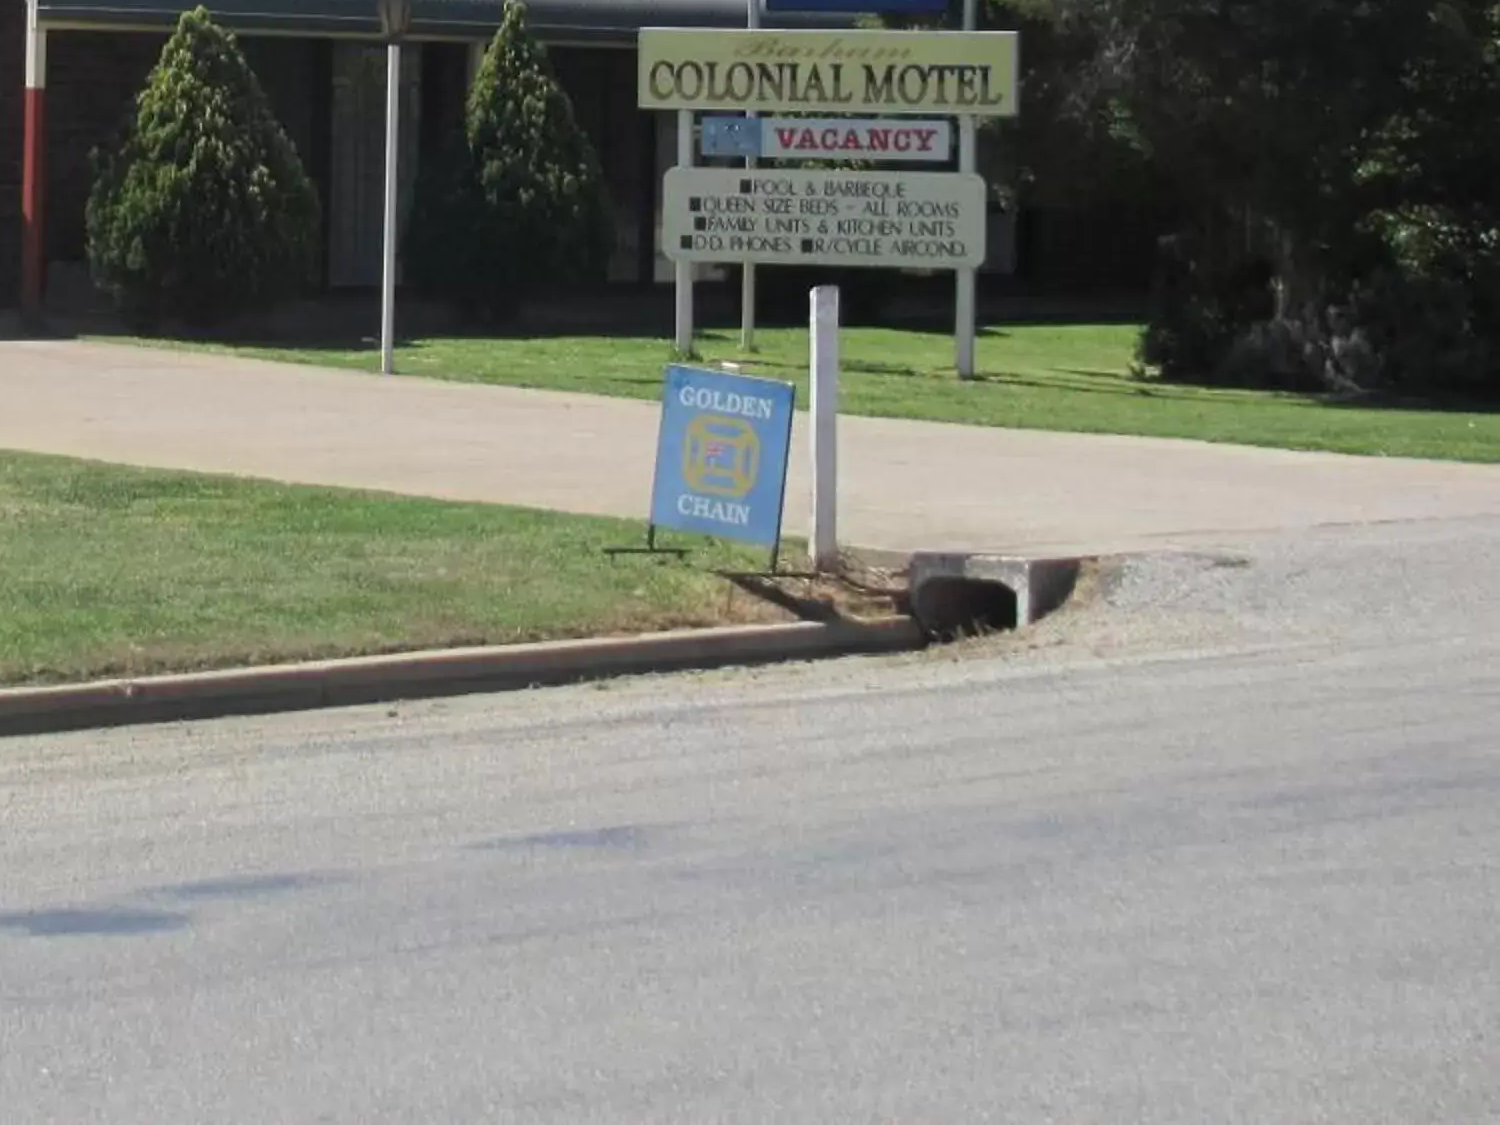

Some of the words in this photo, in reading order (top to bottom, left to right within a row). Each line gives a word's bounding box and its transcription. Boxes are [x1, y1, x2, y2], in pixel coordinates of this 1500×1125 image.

[648, 60, 852, 103] COLONIAL
[861, 64, 1003, 106] MOTEL
[773, 126, 938, 152] VACANCY
[753, 178, 797, 196] POOL
[805, 180, 816, 196] &
[703, 196, 755, 213] QUEEN
[763, 198, 792, 214] SIZE
[800, 198, 838, 215] BEDS
[863, 200, 889, 217] ALL
[897, 200, 960, 219] ROOMS
[707, 215, 758, 232] FAMILY
[765, 217, 810, 234] UNITS
[817, 219, 829, 235] &
[837, 218, 903, 236] KITCHEN
[910, 220, 955, 237] UNITS
[730, 235, 792, 252] PHONES
[815, 238, 883, 256] R/CYCLE
[678, 385, 774, 420] GOLDEN
[676, 493, 752, 525] CHAIN
